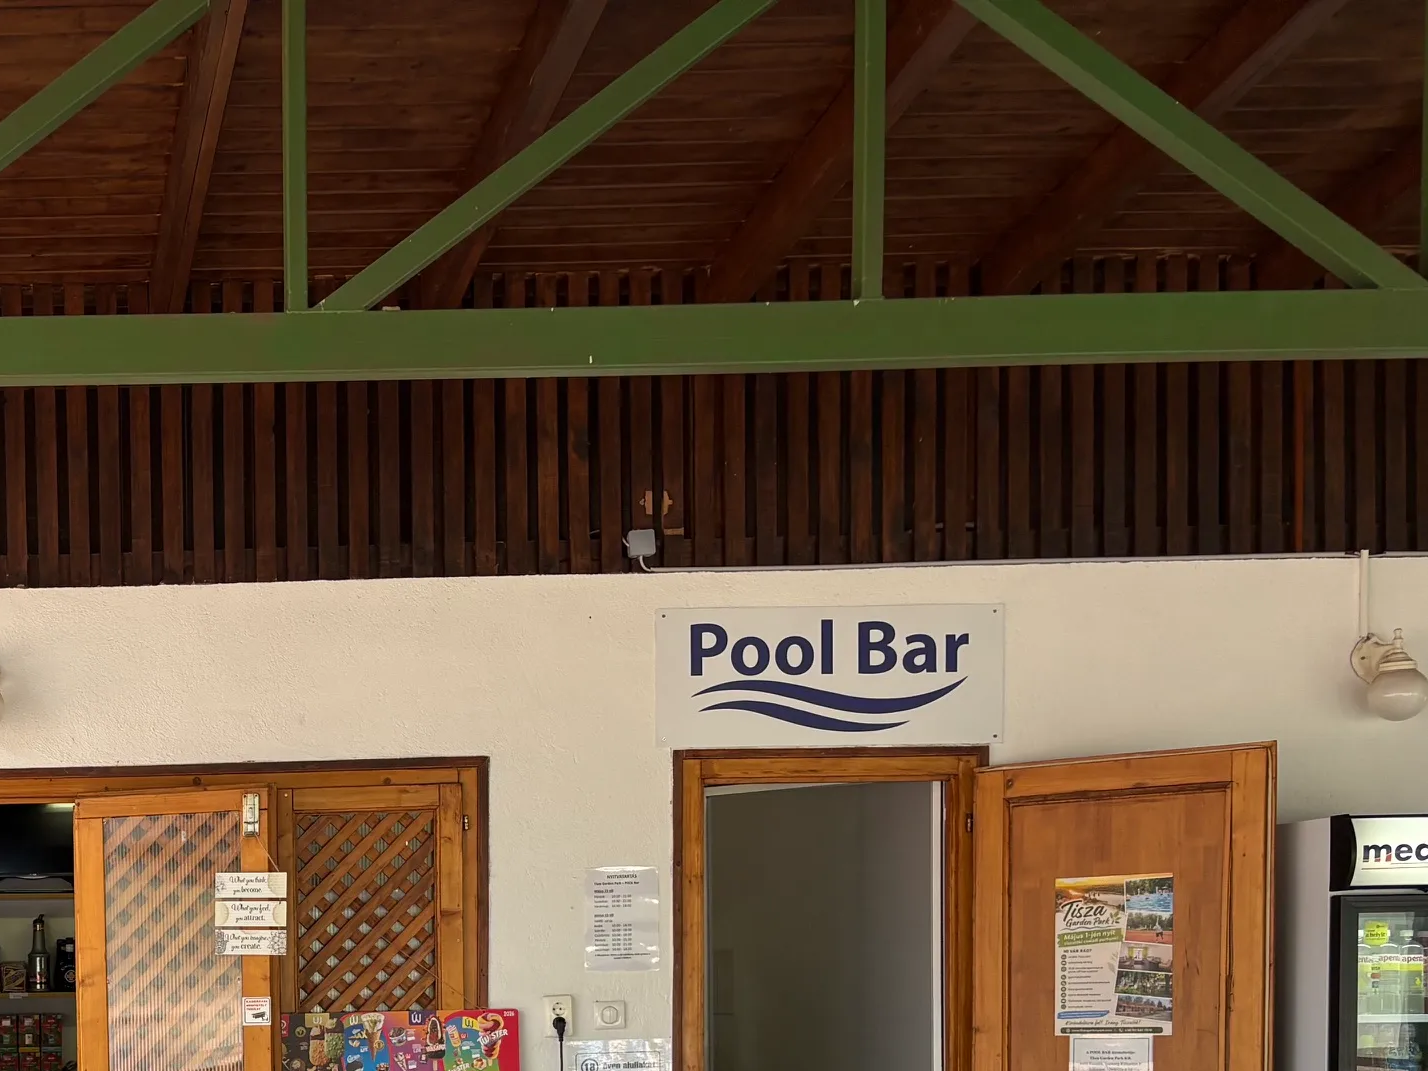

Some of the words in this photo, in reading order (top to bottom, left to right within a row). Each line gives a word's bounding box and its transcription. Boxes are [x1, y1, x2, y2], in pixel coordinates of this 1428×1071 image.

[690, 619, 834, 676] Pool
[857, 621, 969, 675] Bar
[1060, 899, 1107, 922] Tisza
[1065, 918, 1092, 927] Garden
[1093, 917, 1110, 926] Park
[411, 1011, 422, 1023] ÚJ
[584, 1063, 596, 1071] 18
